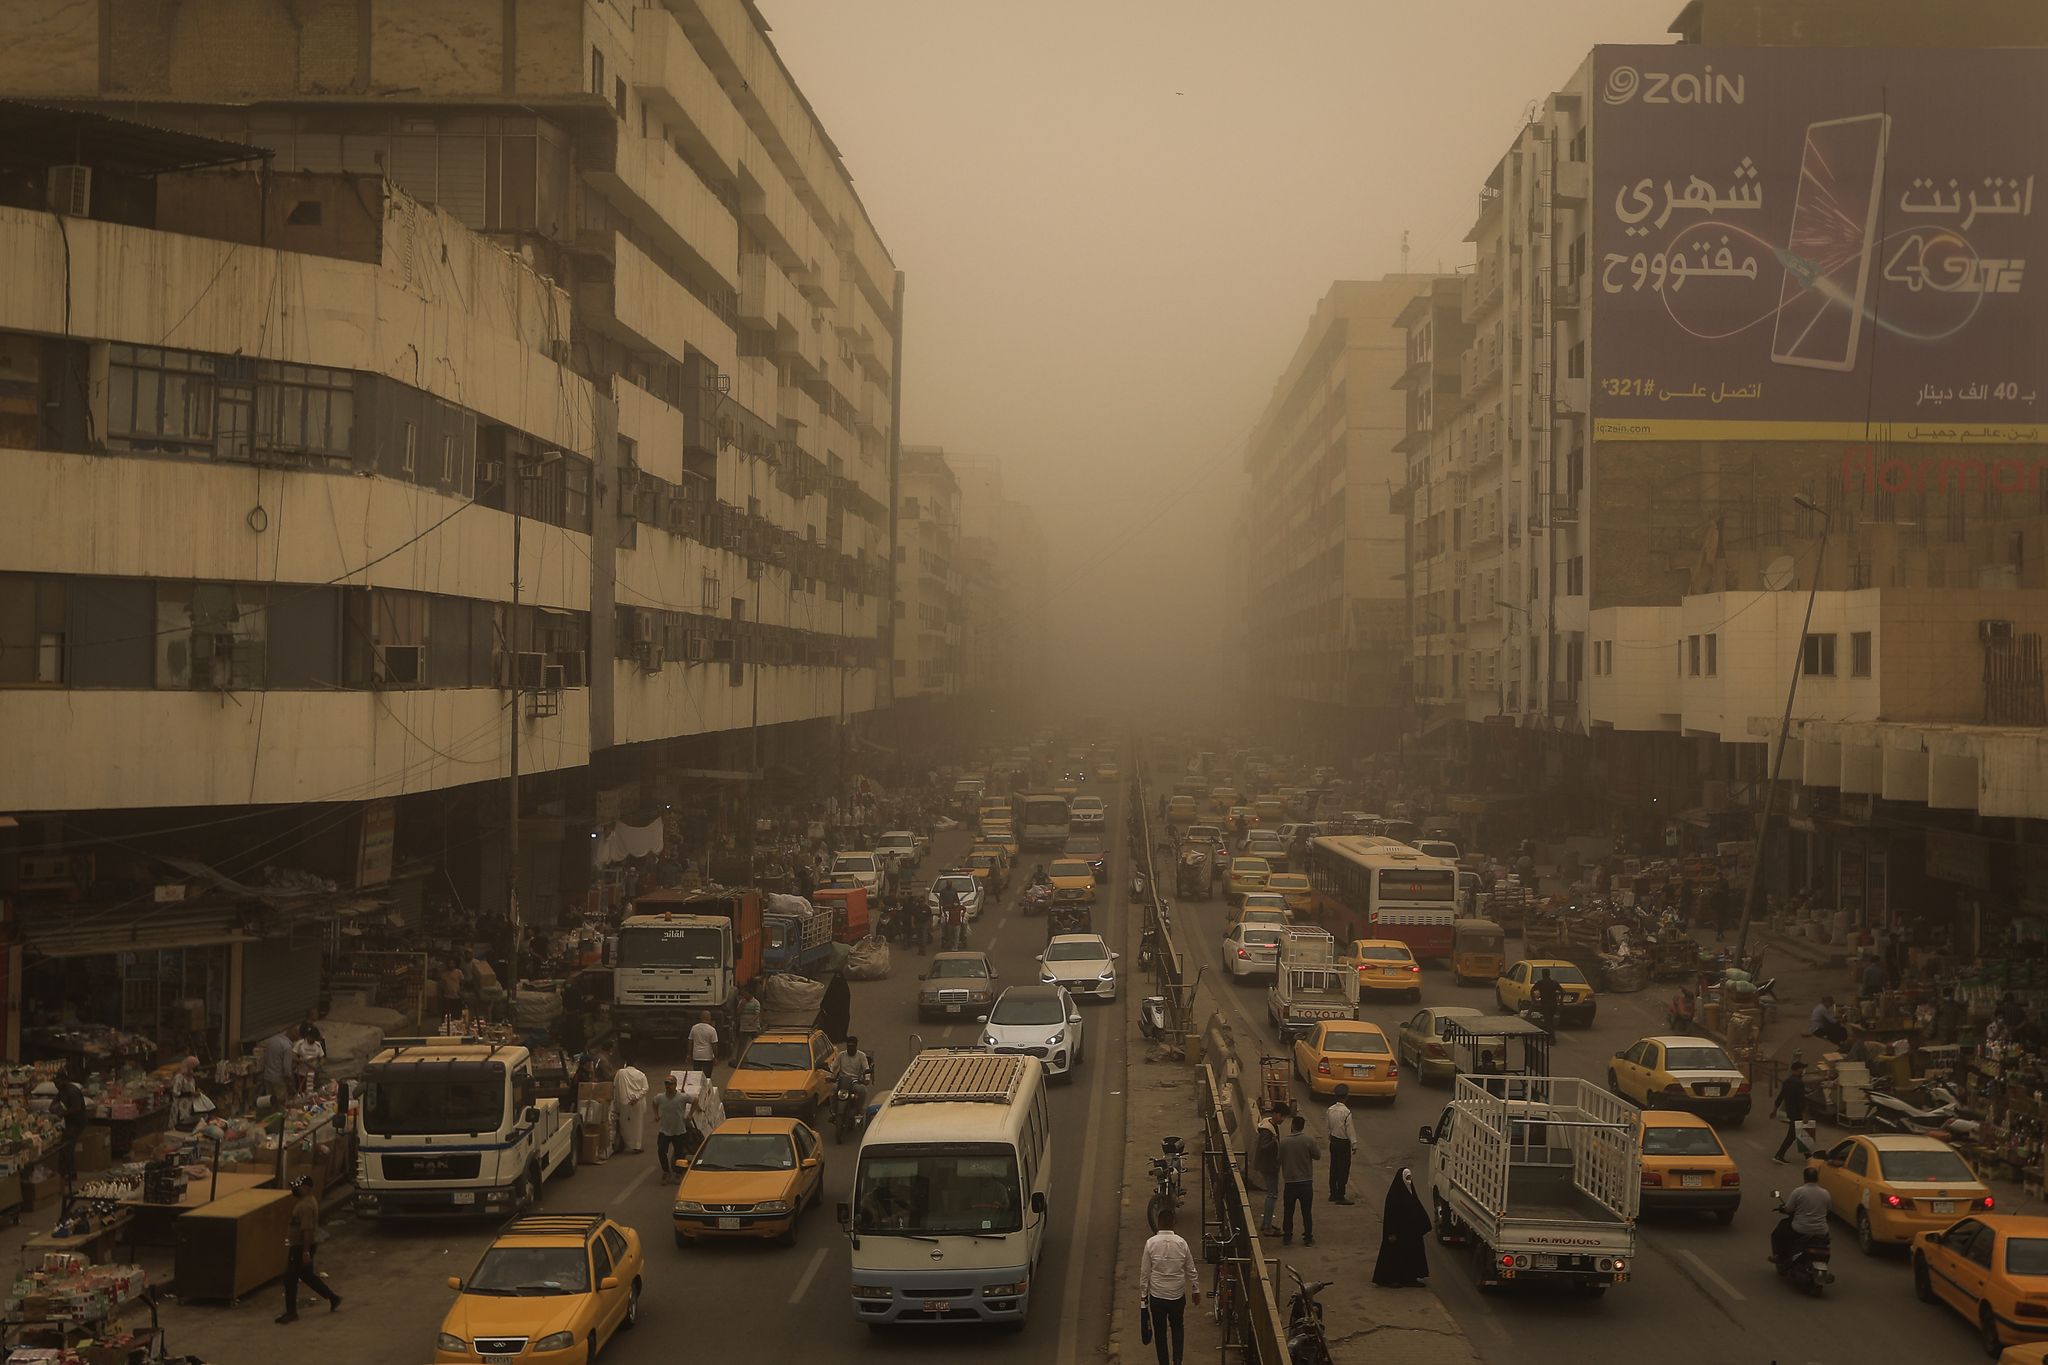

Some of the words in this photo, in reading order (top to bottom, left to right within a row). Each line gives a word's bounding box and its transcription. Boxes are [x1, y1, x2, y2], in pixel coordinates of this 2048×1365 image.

[1642, 64, 1745, 105] zain
[1615, 156, 1763, 237] شهري
[1899, 175, 2035, 231] انترنت
[1601, 235, 1759, 294] مفتوووح
[1658, 382, 1707, 401] على
[1711, 382, 1763, 403] اتصل
[1915, 383, 1954, 406] دينار
[1958, 382, 1989, 401] الف
[1993, 381, 2018, 401] 40
[1907, 425, 1957, 441] جميل
[1297, 1009, 1346, 1020] TOYOTA
